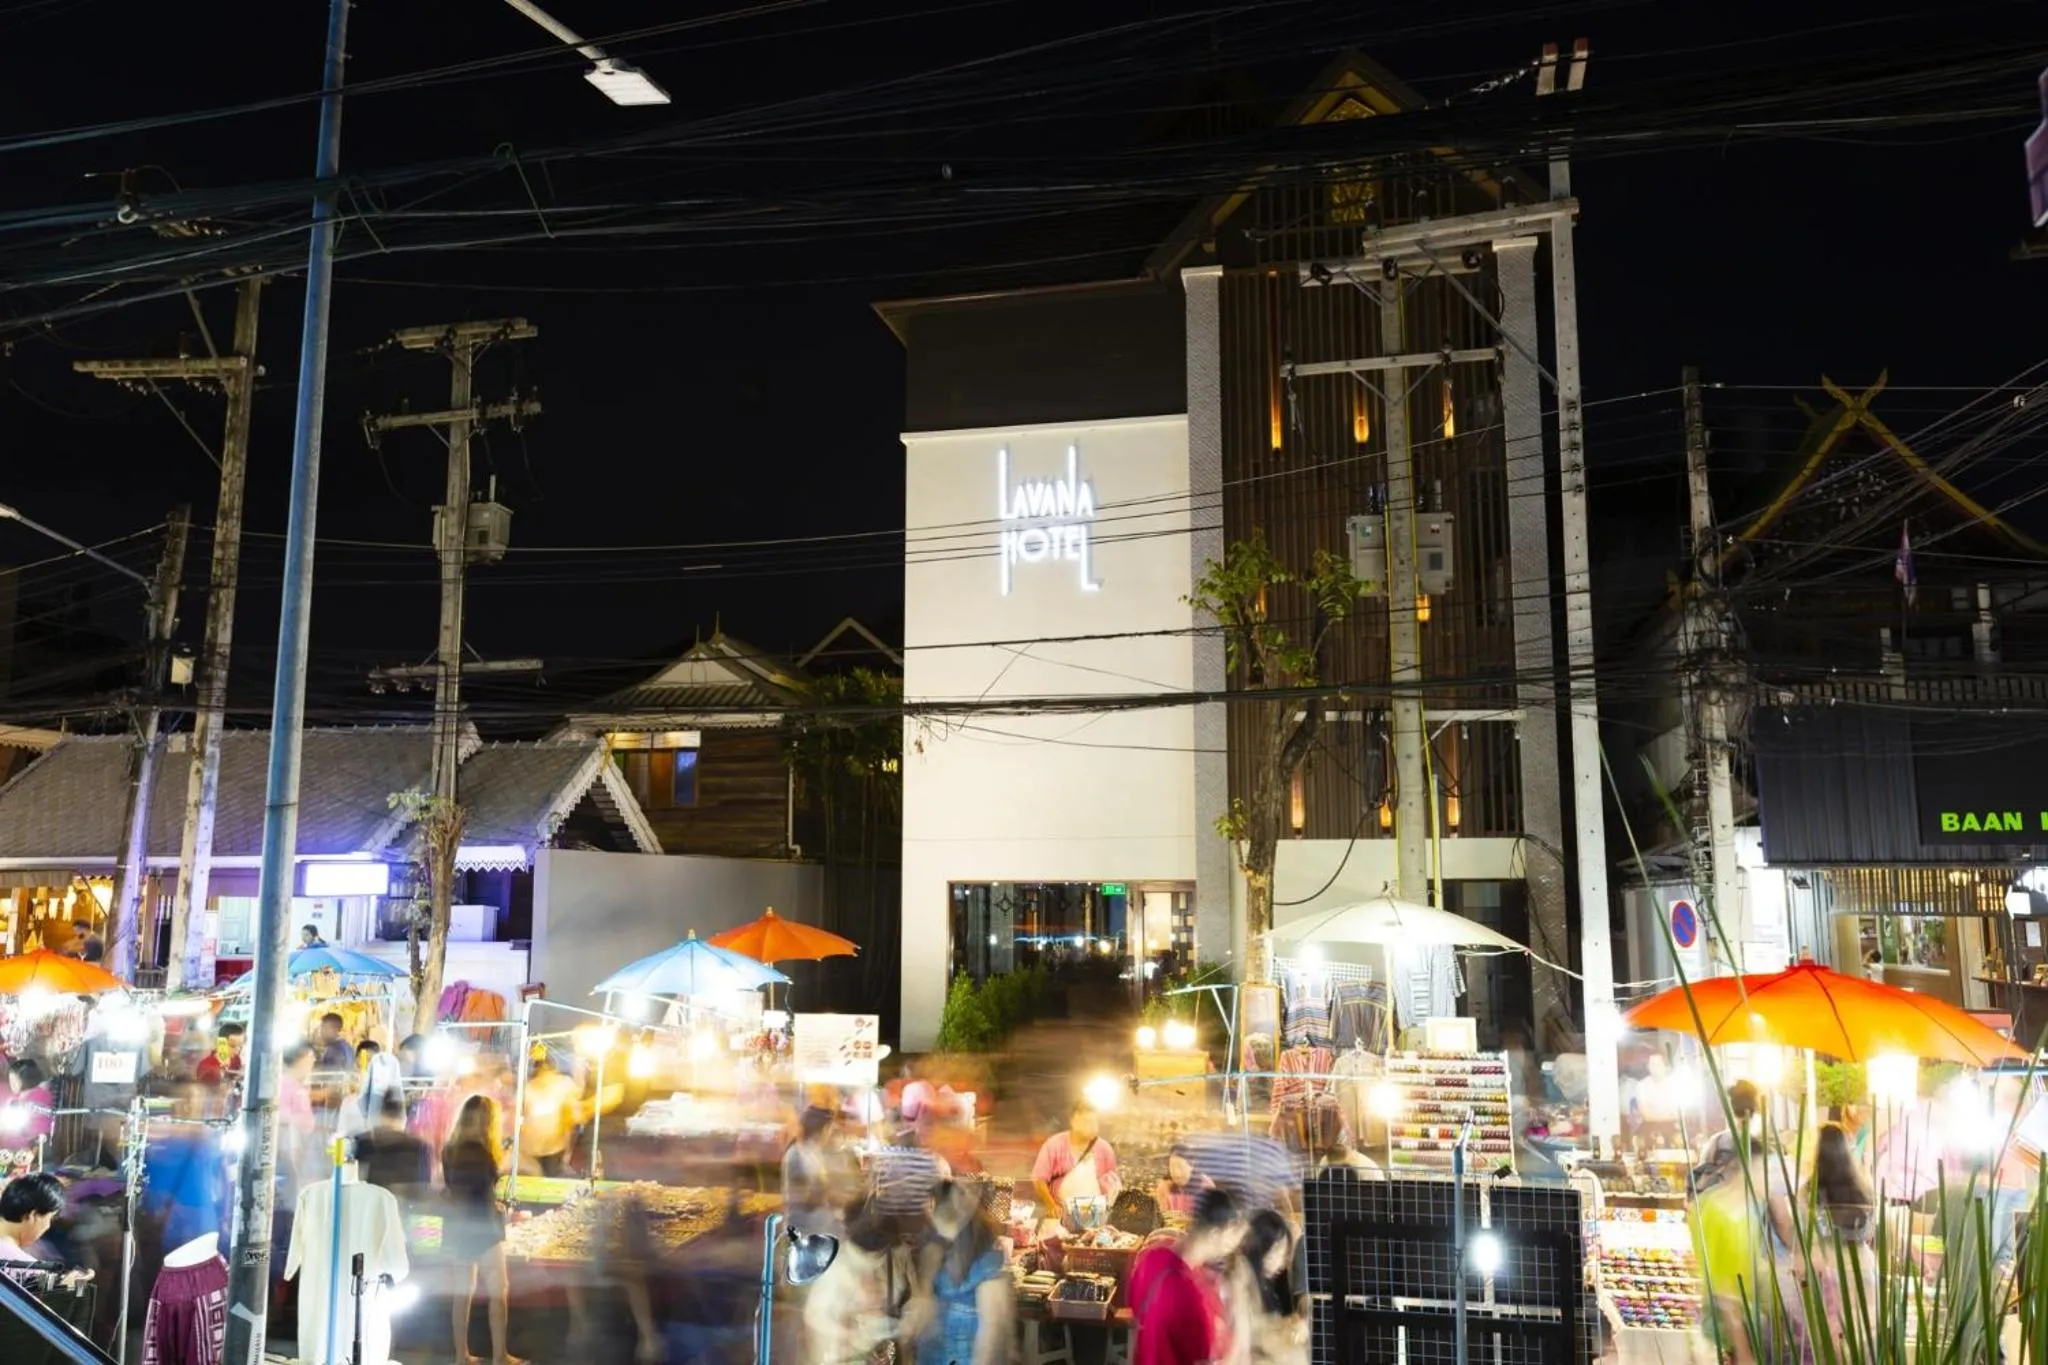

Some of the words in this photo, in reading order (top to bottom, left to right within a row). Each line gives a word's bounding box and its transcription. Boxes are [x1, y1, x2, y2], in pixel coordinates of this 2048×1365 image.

[999, 445, 1094, 519] LAVANA
[1001, 524, 1100, 597] HOTEL
[1941, 811, 2024, 832] BAAN
